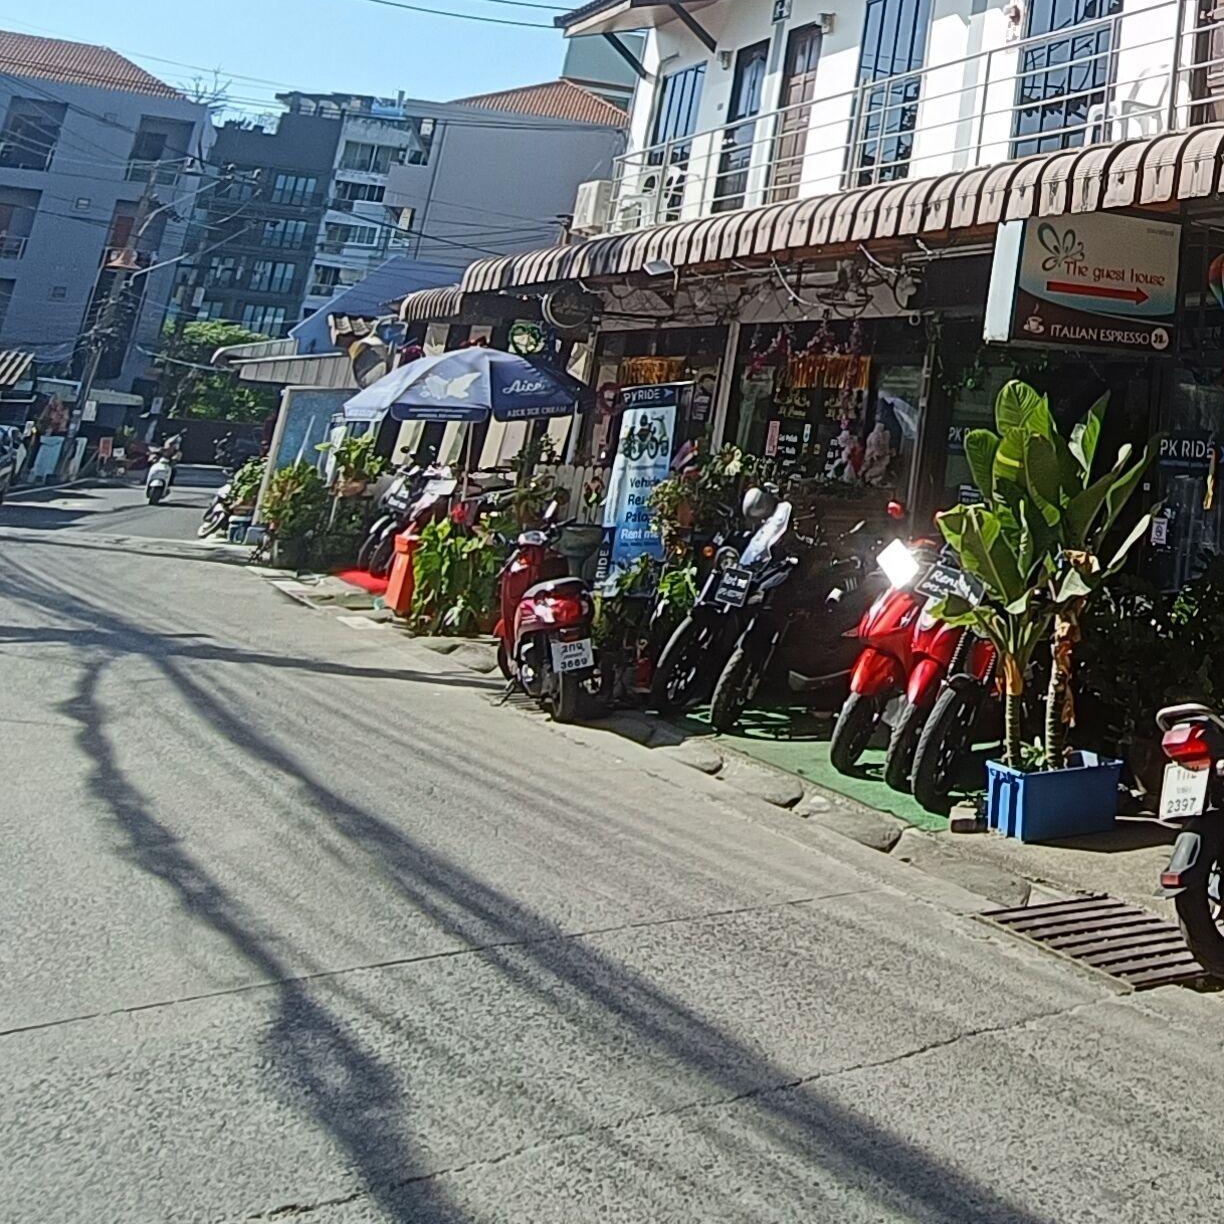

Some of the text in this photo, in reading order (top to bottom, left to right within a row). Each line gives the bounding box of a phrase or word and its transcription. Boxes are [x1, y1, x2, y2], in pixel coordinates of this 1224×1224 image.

[1064, 260, 1165, 286] The guest house
[1051, 324, 1150, 345] ITALIAN ESPRESSO
[1160, 439, 1215, 459] PK RIDE
[1167, 797, 1197, 814] 2397
